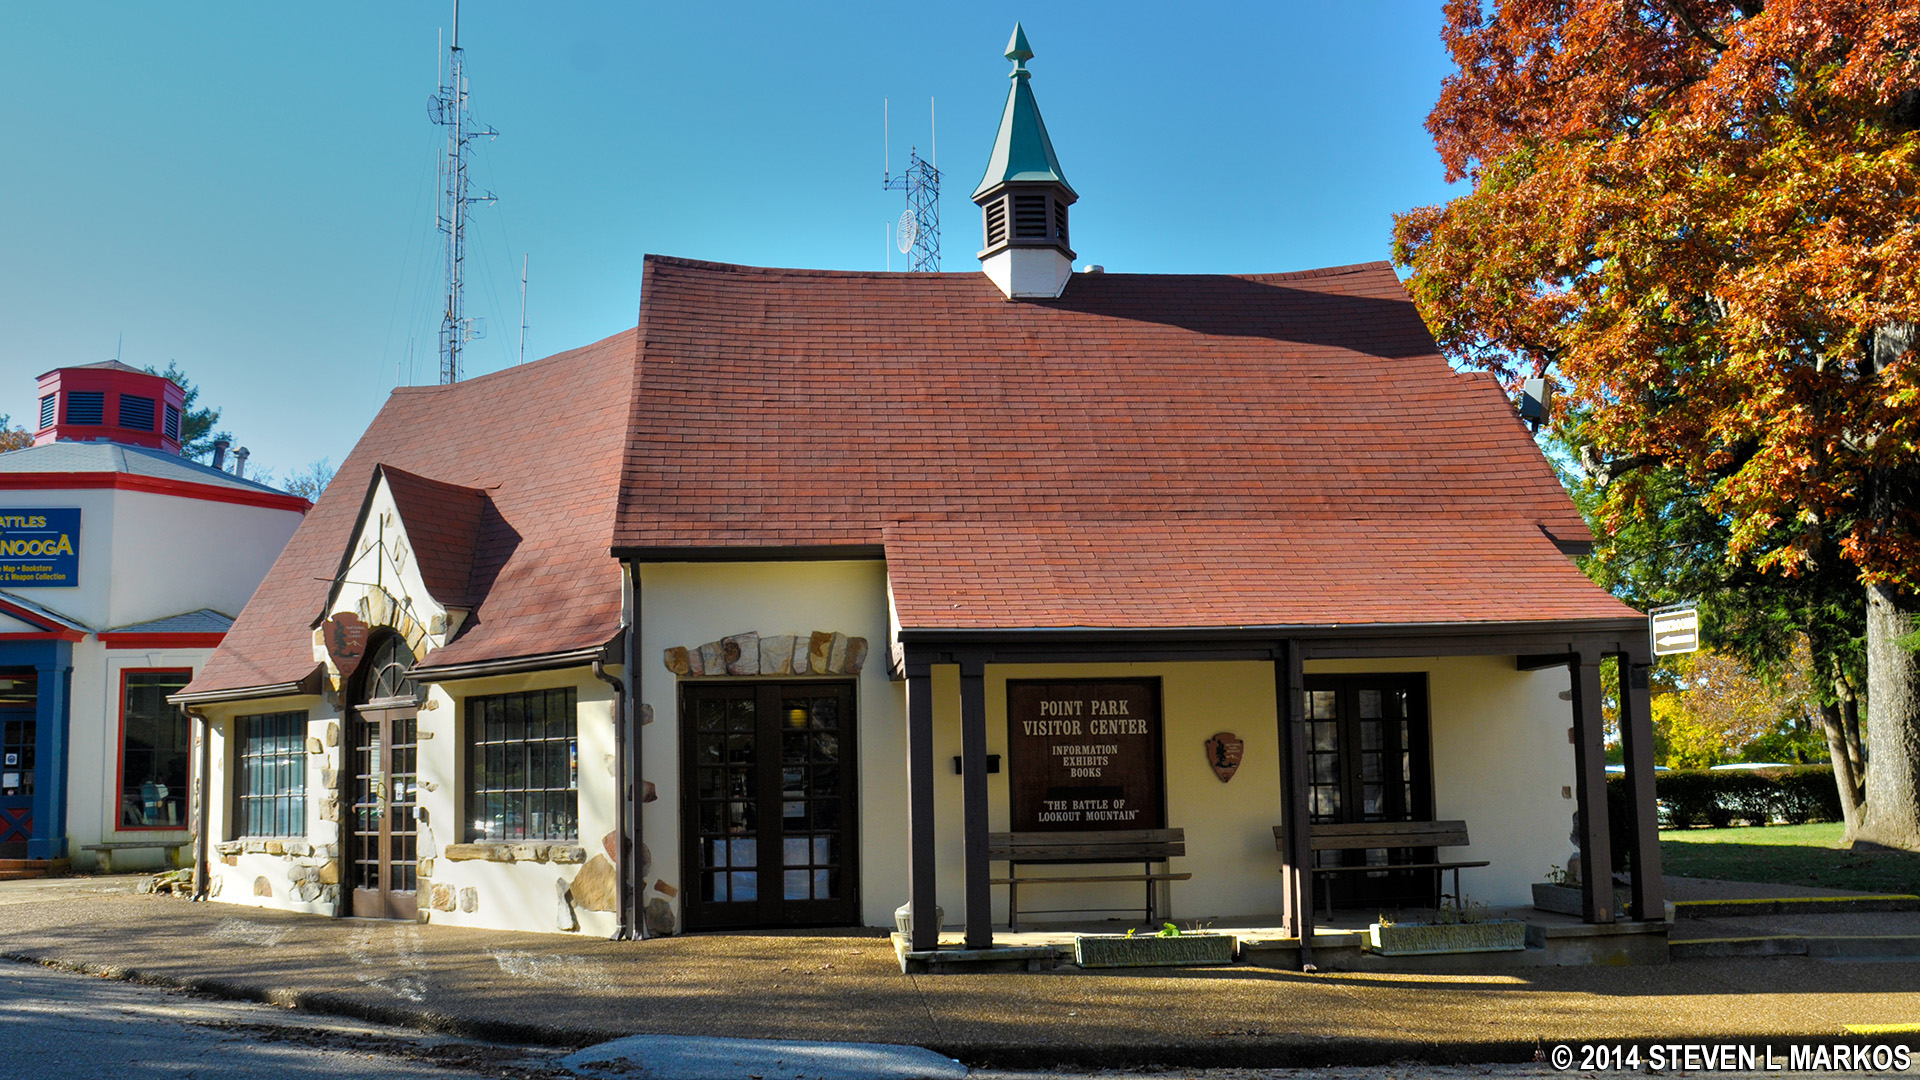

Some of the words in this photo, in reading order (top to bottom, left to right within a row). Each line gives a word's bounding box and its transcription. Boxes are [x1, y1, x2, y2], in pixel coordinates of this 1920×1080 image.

[3, 565, 16, 573] Map
[1040, 701, 1083, 716] POINT
[1091, 700, 1130, 715] PARK
[1022, 720, 1082, 736] VISITOR
[1090, 719, 1148, 735] CENTER
[1052, 745, 1118, 756] INFORMATION
[1063, 756, 1109, 767] EXHIBITS
[1070, 767, 1102, 778] BOOKS
[1072, 800, 1108, 810] BATTLE
[1113, 799, 1126, 810] OF
[1038, 811, 1081, 822] LOOKOUT
